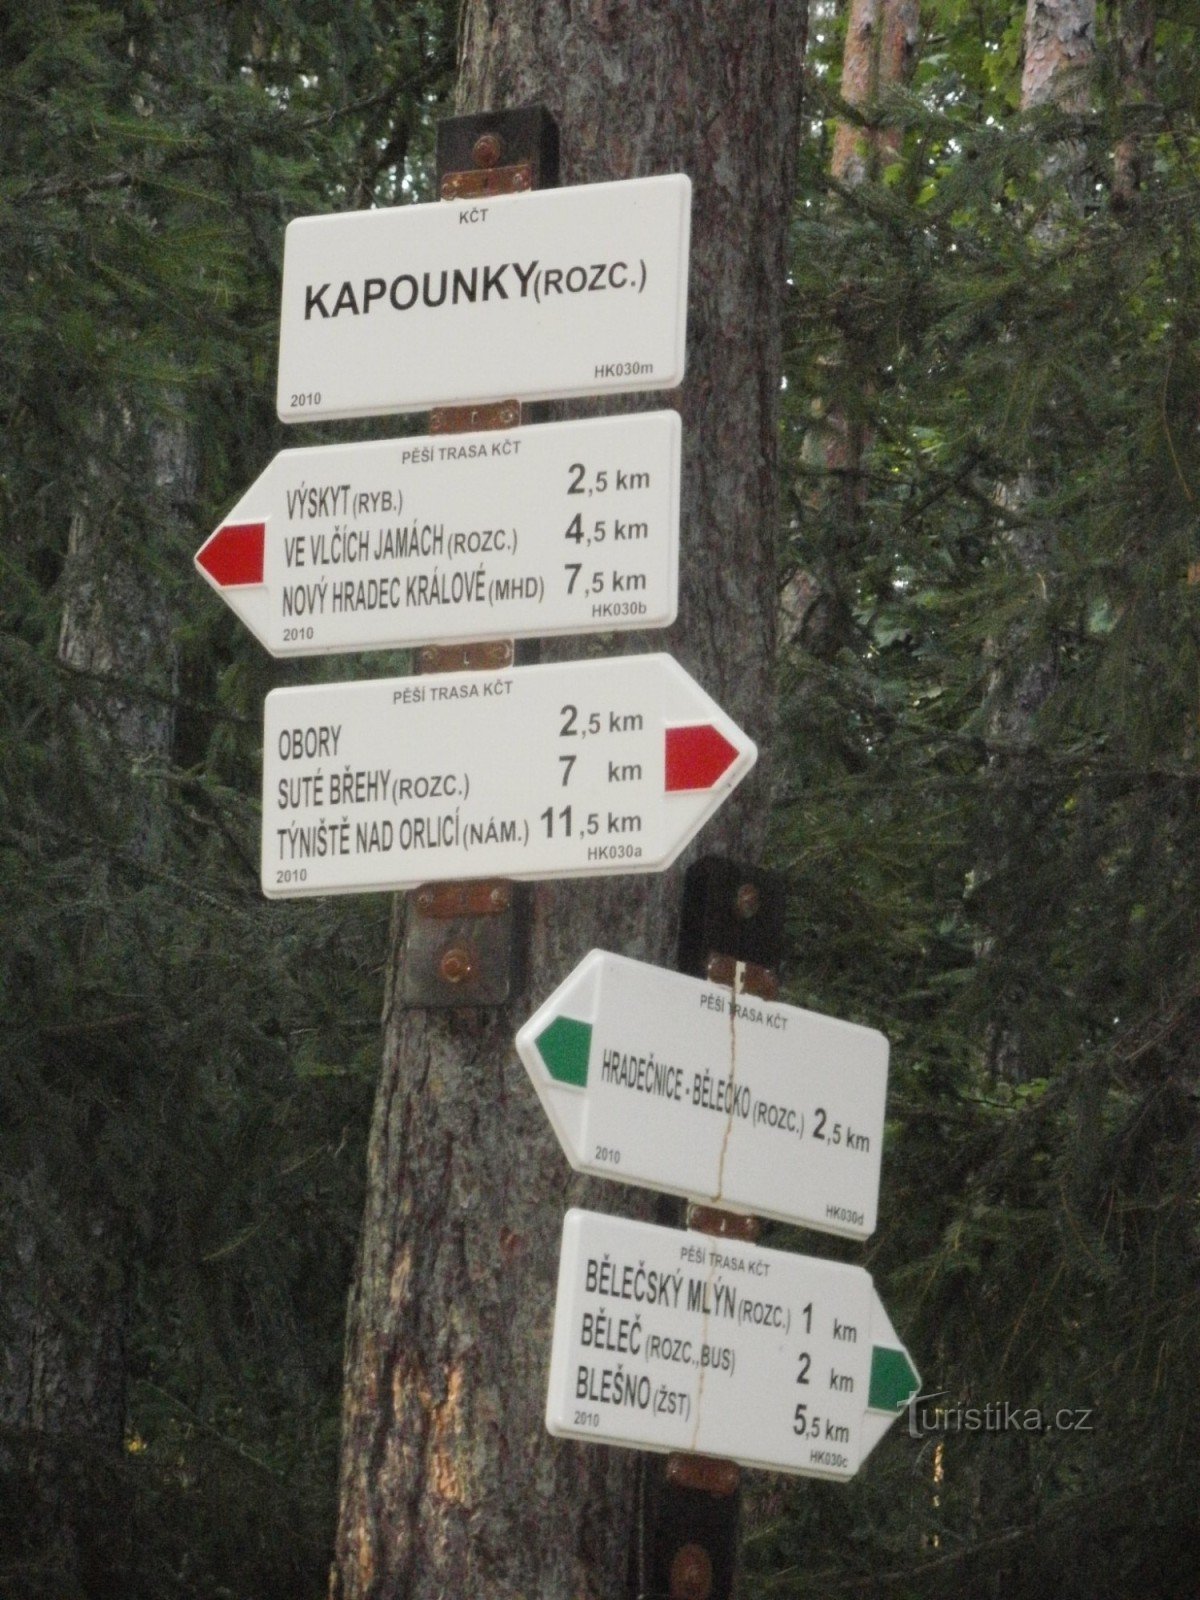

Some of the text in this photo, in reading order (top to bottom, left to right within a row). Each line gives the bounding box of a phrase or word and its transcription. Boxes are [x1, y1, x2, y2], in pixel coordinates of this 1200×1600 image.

[459, 207, 489, 225] KČT
[594, 361, 654, 380] HK030m
[290, 391, 322, 408] 2010
[402, 440, 522, 465] PĚŠÍ TRASA KČT
[566, 463, 609, 497] 2,5
[615, 467, 651, 490] km
[284, 536, 305, 568] VE
[310, 525, 369, 566] VLČÍCH
[564, 513, 606, 547] 4,5
[613, 517, 649, 540] km
[281, 575, 327, 617] NOVÝ
[331, 577, 400, 612] HRADEC
[564, 563, 605, 597] 7,5
[611, 567, 647, 592] km
[591, 602, 648, 618] HK030b
[282, 627, 314, 642] 2010
[392, 680, 514, 705] PĚŠÍ TRASA KČT
[278, 704, 643, 761] OBORY 2,5 km
[277, 770, 323, 810] SUTÉ
[558, 755, 577, 787] 7
[607, 761, 643, 783] km
[277, 819, 350, 861] TÝNIŠTĚ
[355, 820, 394, 854] NAD
[539, 805, 600, 841] 11,5
[606, 812, 642, 835] km
[587, 845, 643, 862] HK030a
[275, 868, 308, 885] 2010
[699, 993, 788, 1030] PĚŠÍ TRASA KČT
[601, 1048, 683, 1101] HRADEČNICE
[812, 1107, 842, 1145] 2,5
[845, 1127, 870, 1153] km
[595, 1145, 621, 1164] 2010
[825, 1204, 864, 1226] HK030d
[680, 1246, 770, 1277] PĚŠÍ TRASA KČT
[585, 1253, 684, 1308] BĚLEČSKÝ
[802, 1303, 813, 1334] 1
[832, 1318, 858, 1344] km
[796, 1352, 811, 1386] 2
[829, 1367, 855, 1393] km
[573, 1411, 600, 1427] 2010
[792, 1403, 822, 1438] 5,5
[824, 1416, 850, 1444] km
[809, 1449, 849, 1469] HK030c
